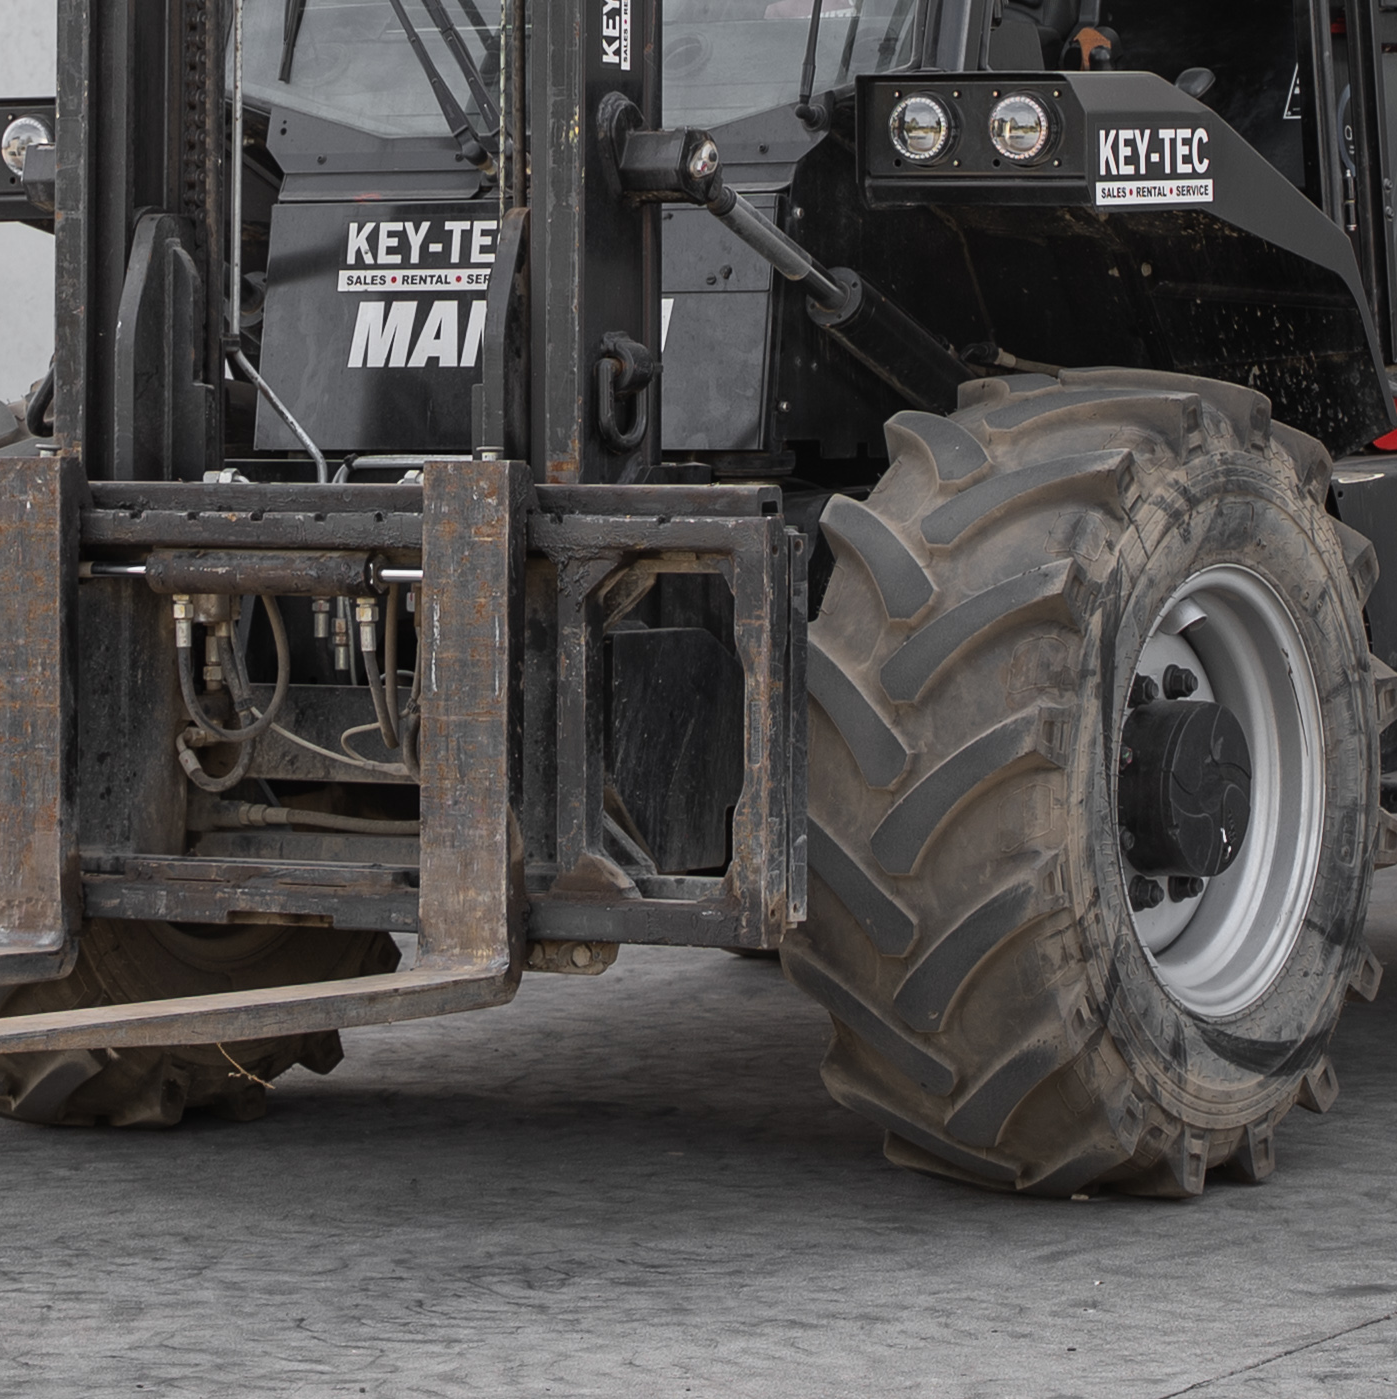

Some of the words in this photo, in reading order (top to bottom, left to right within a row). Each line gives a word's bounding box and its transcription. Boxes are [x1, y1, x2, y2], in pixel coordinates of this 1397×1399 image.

[1099, 127, 1210, 176] KEY-TEC
[1101, 186, 1127, 199] SALES
[1136, 185, 1167, 198] RENTAL
[1176, 184, 1209, 197] SERVICE
[346, 220, 501, 265] KEY-TE
[346, 274, 387, 286] SALES
[401, 274, 452, 286] RENTAL
